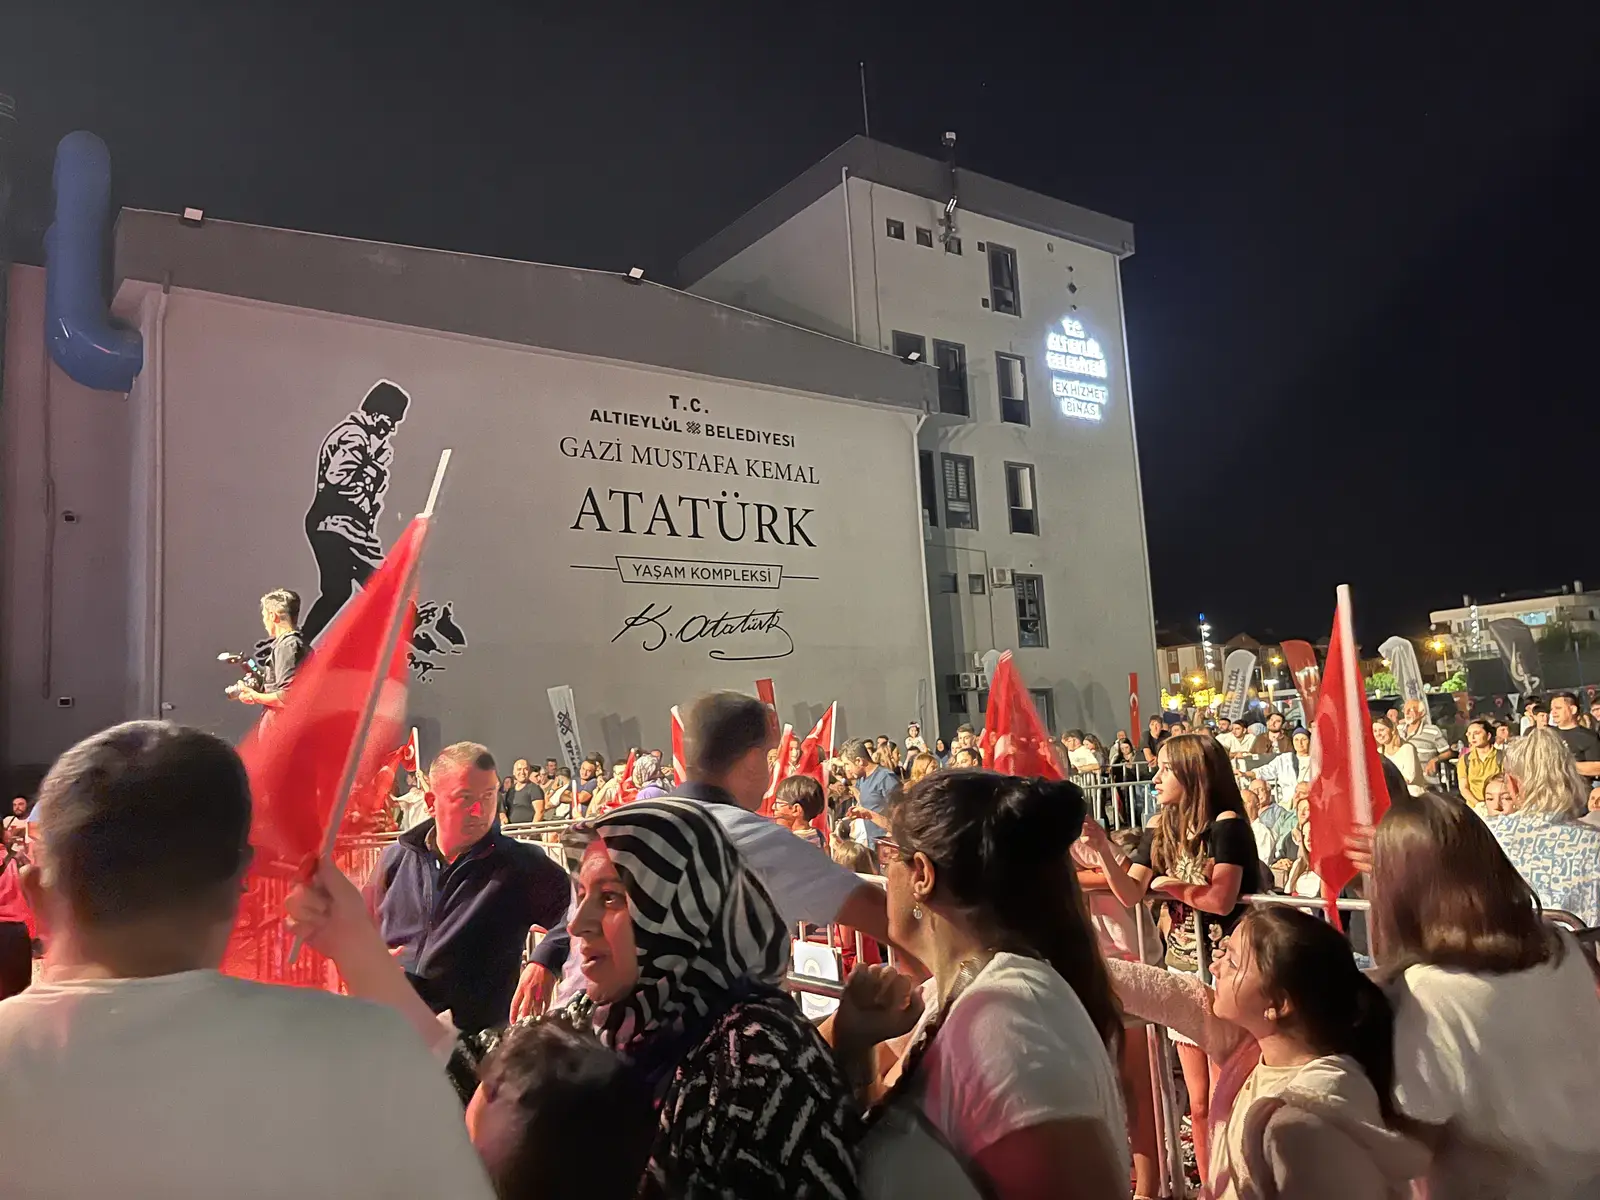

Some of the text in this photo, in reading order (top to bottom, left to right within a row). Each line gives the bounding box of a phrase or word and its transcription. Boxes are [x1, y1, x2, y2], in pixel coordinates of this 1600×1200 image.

[669, 395, 709, 413] T.C.
[559, 437, 820, 484] GAZİ MUSTAFA KEMAL
[570, 487, 817, 547] ATATÜRK
[632, 564, 772, 582] YAŞAM KOMPLEKSİ
